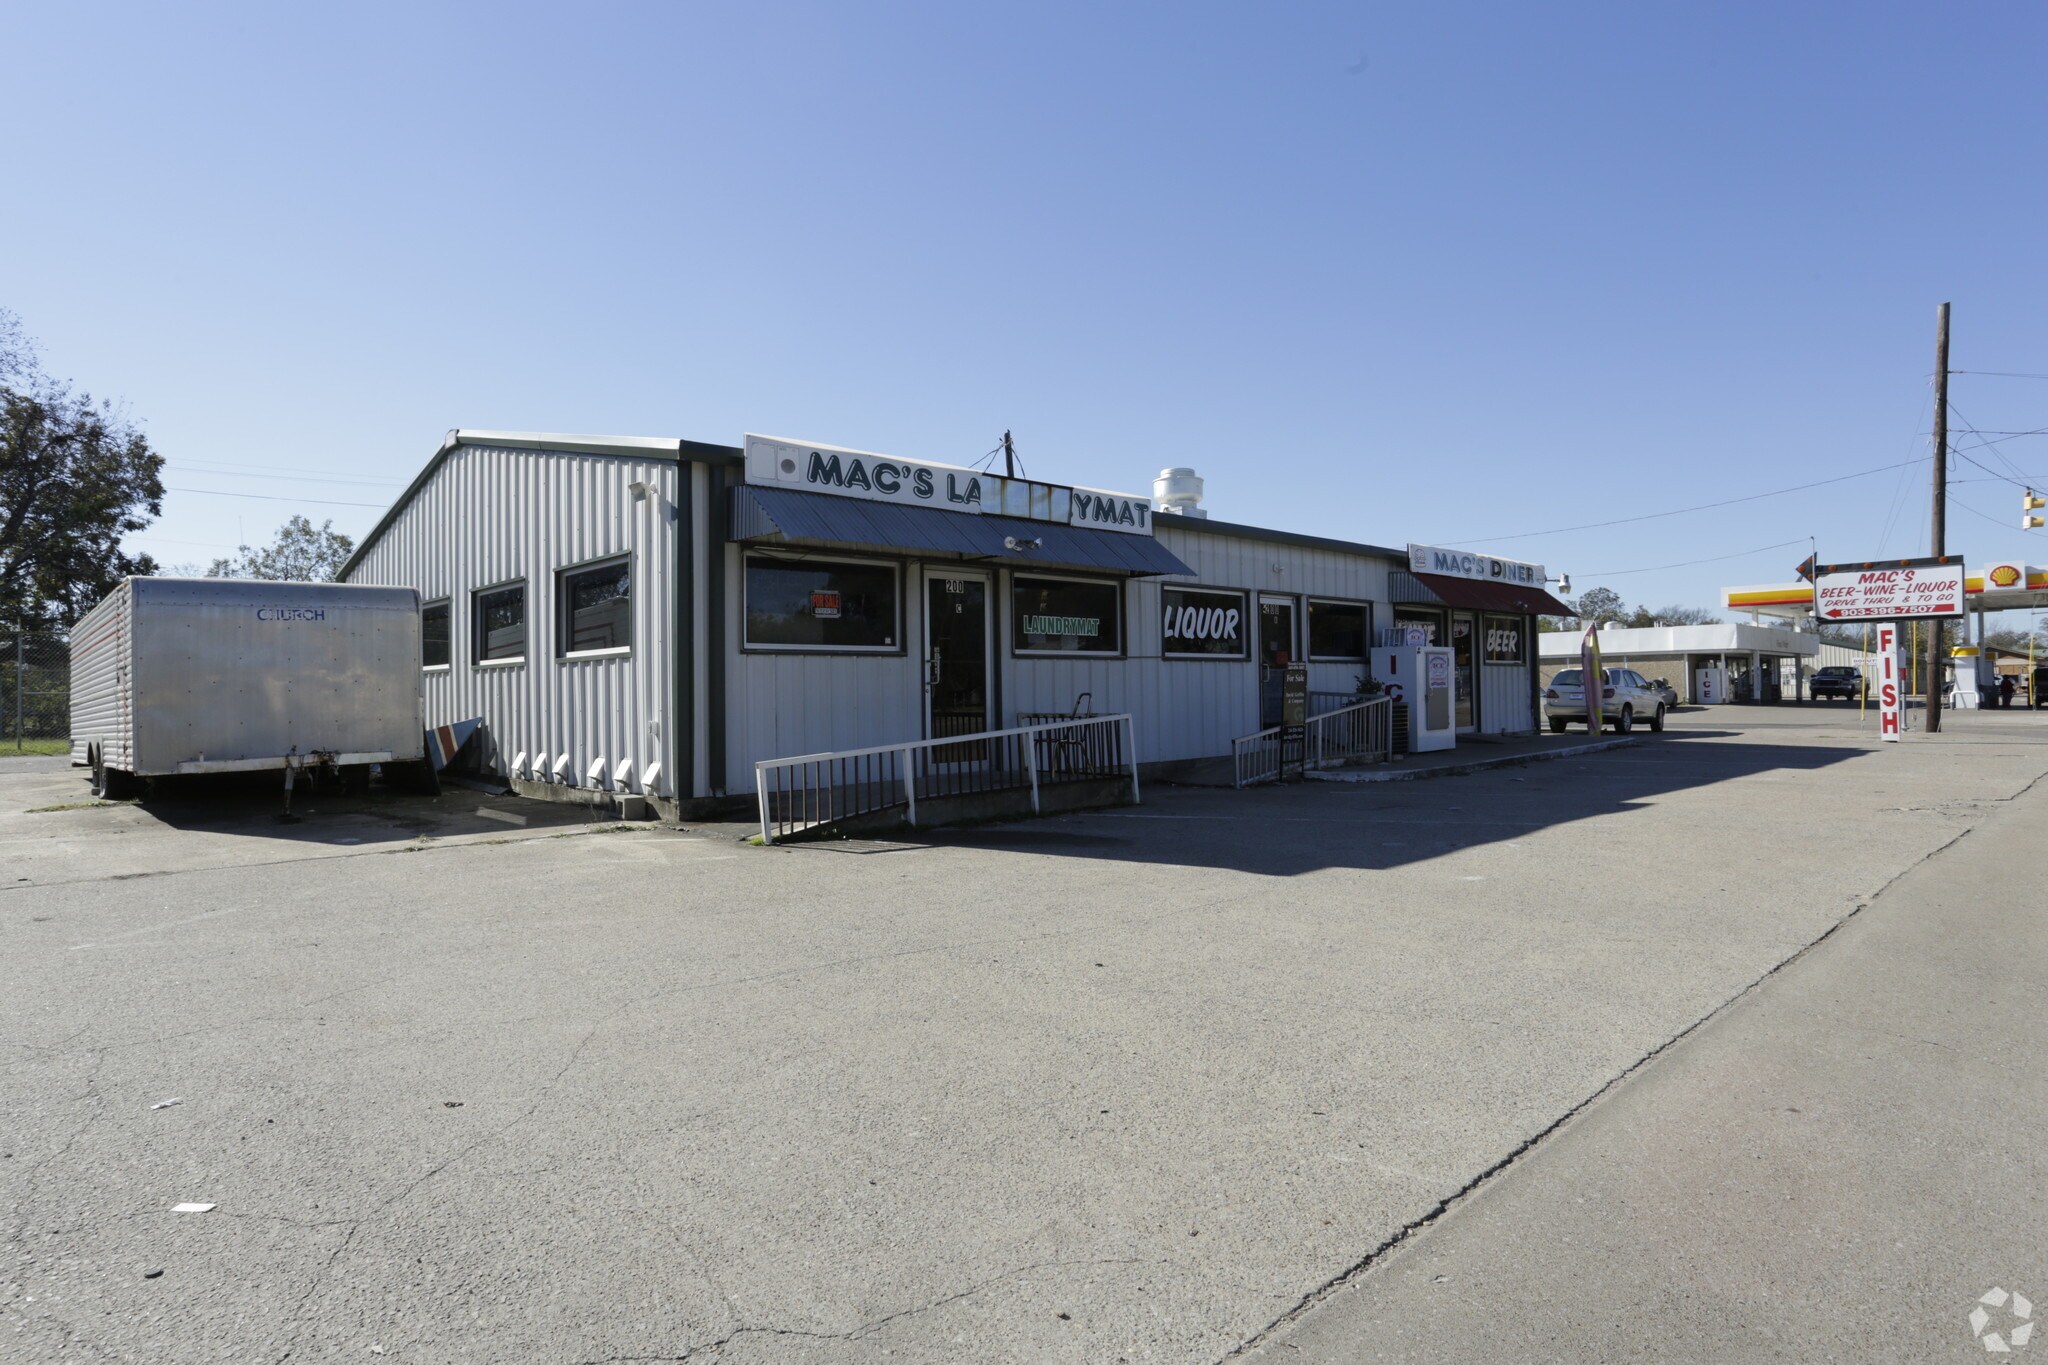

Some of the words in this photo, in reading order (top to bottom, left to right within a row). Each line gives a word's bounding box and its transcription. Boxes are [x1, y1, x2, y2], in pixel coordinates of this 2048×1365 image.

[807, 451, 934, 499] MAC'S
[1433, 551, 1485, 576] MAC'S
[1490, 559, 1534, 584] DINER
[1858, 569, 1916, 585] MAC'S
[946, 580, 963, 593] 200
[812, 594, 825, 608] FOR
[825, 594, 841, 609] SALE
[1824, 598, 1860, 607] DRIVE
[1862, 596, 1893, 606] THRU
[1902, 596, 1910, 604] &
[1918, 594, 1932, 603] TO
[1936, 593, 1954, 602] GO
[1841, 605, 1936, 616] 903-396-7507
[1022, 614, 1100, 636] LAUNDRYMAT
[1164, 605, 1240, 640] LIQUOR
[1486, 628, 1519, 654] BEER
[1703, 671, 1711, 698] ICE
[1880, 630, 1900, 735] FISH
